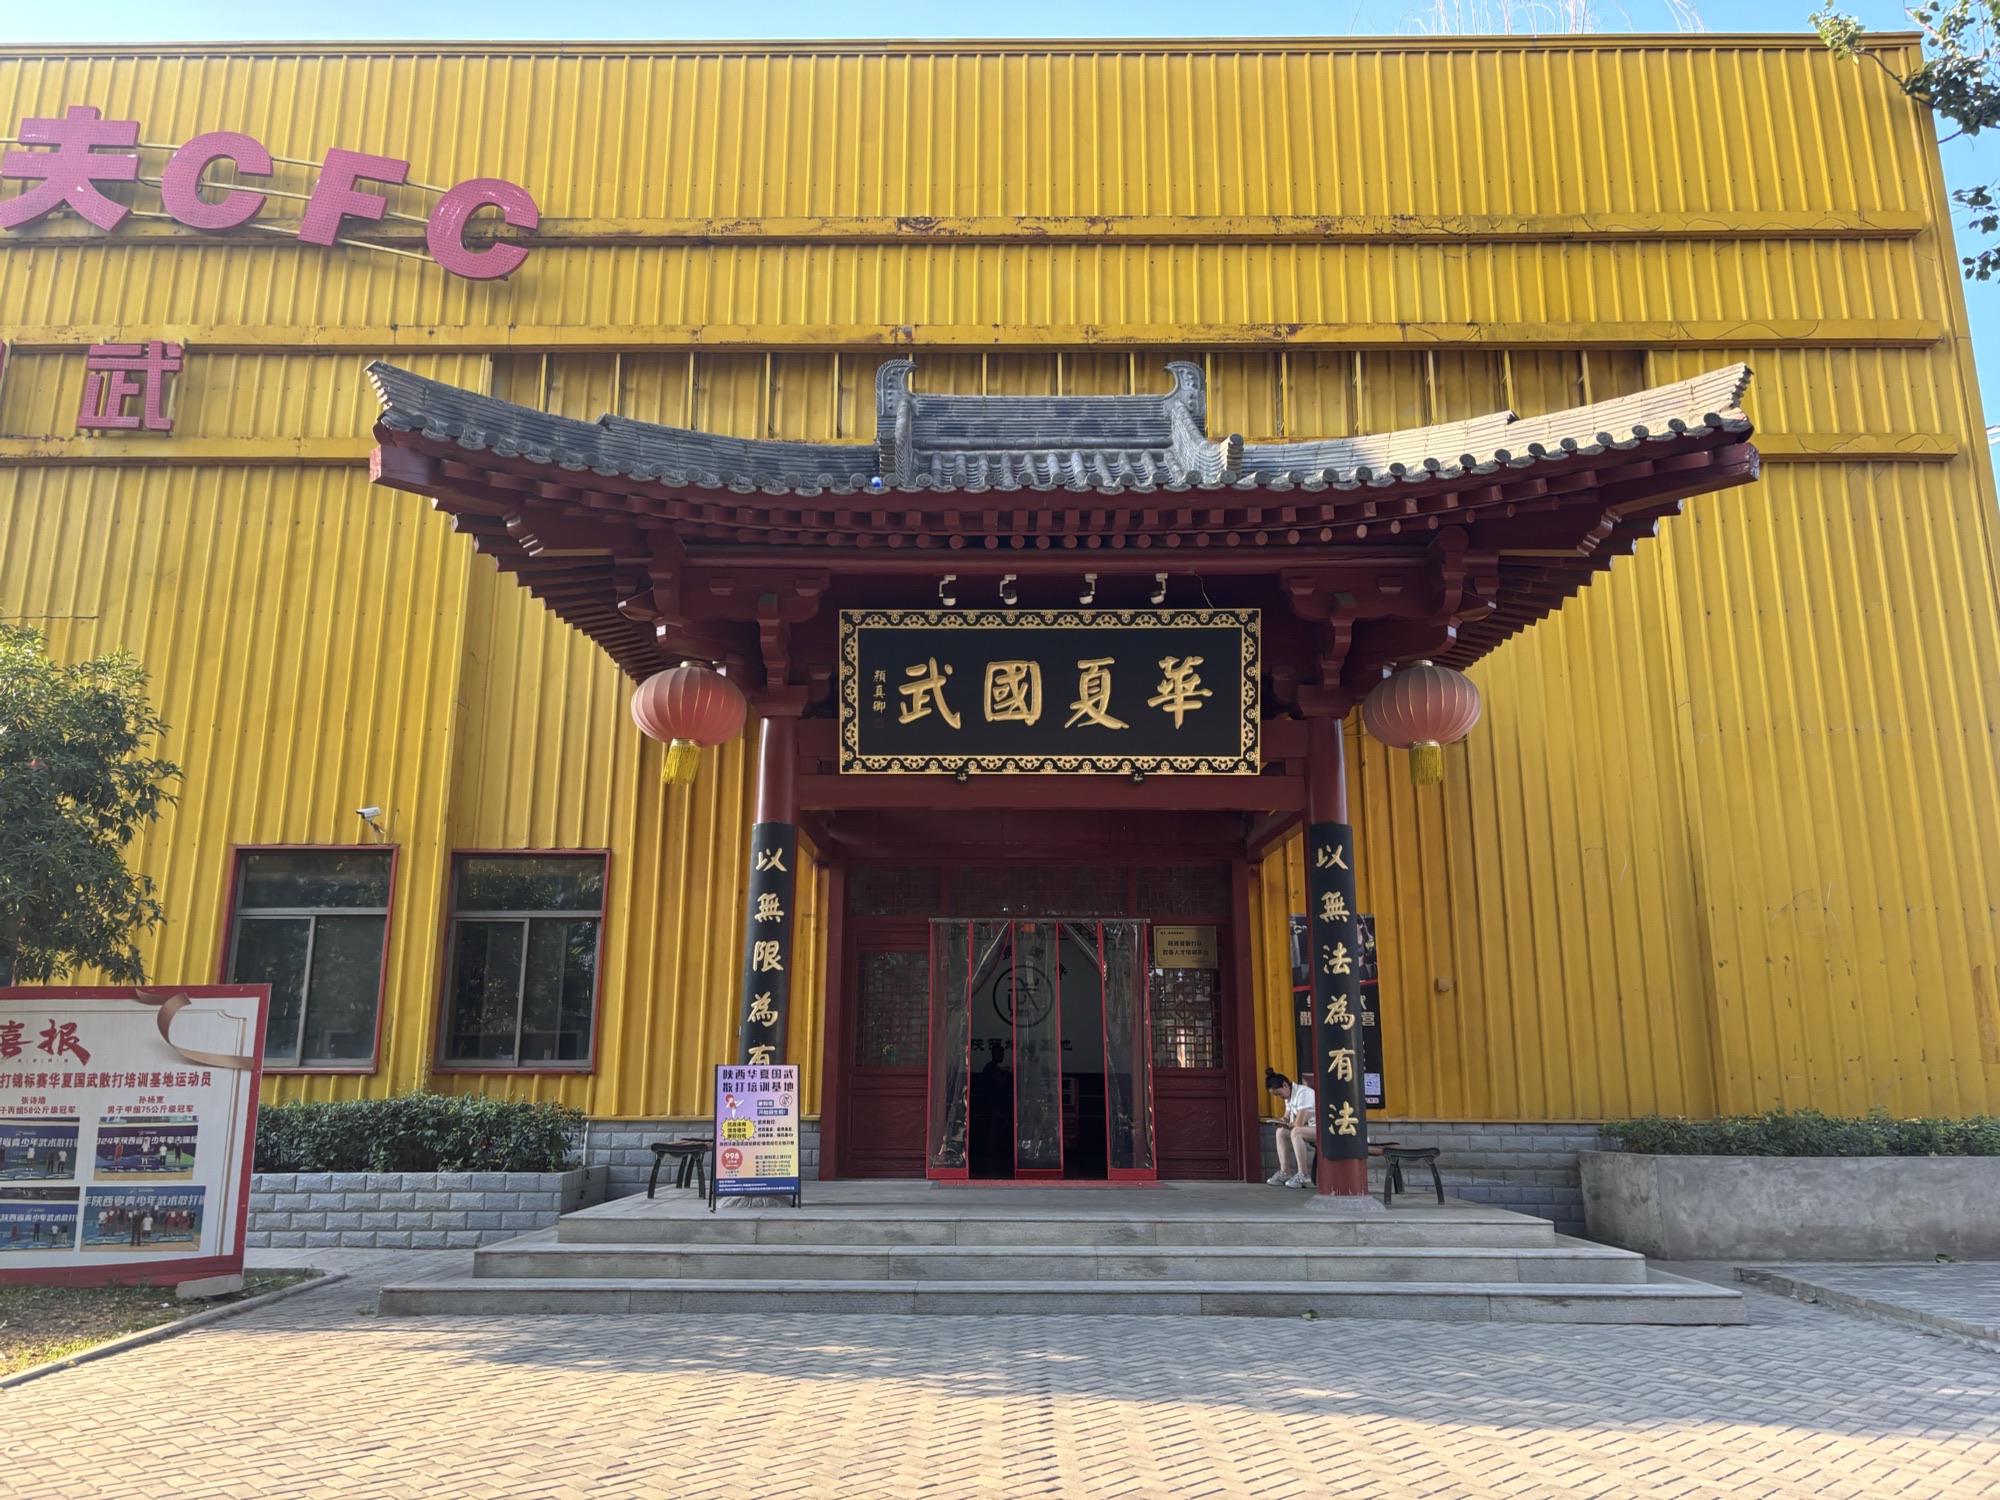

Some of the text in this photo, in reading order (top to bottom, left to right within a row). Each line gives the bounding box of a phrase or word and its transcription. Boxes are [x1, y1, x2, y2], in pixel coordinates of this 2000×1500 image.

[77, 340, 183, 430] 武
[0, 1018, 91, 1066] 喜报
[722, 1068, 794, 1080] 陕西华夏国武
[722, 1081, 794, 1093] 散打培训基地
[0, 1137, 78, 1148] 省青少年武术散打
